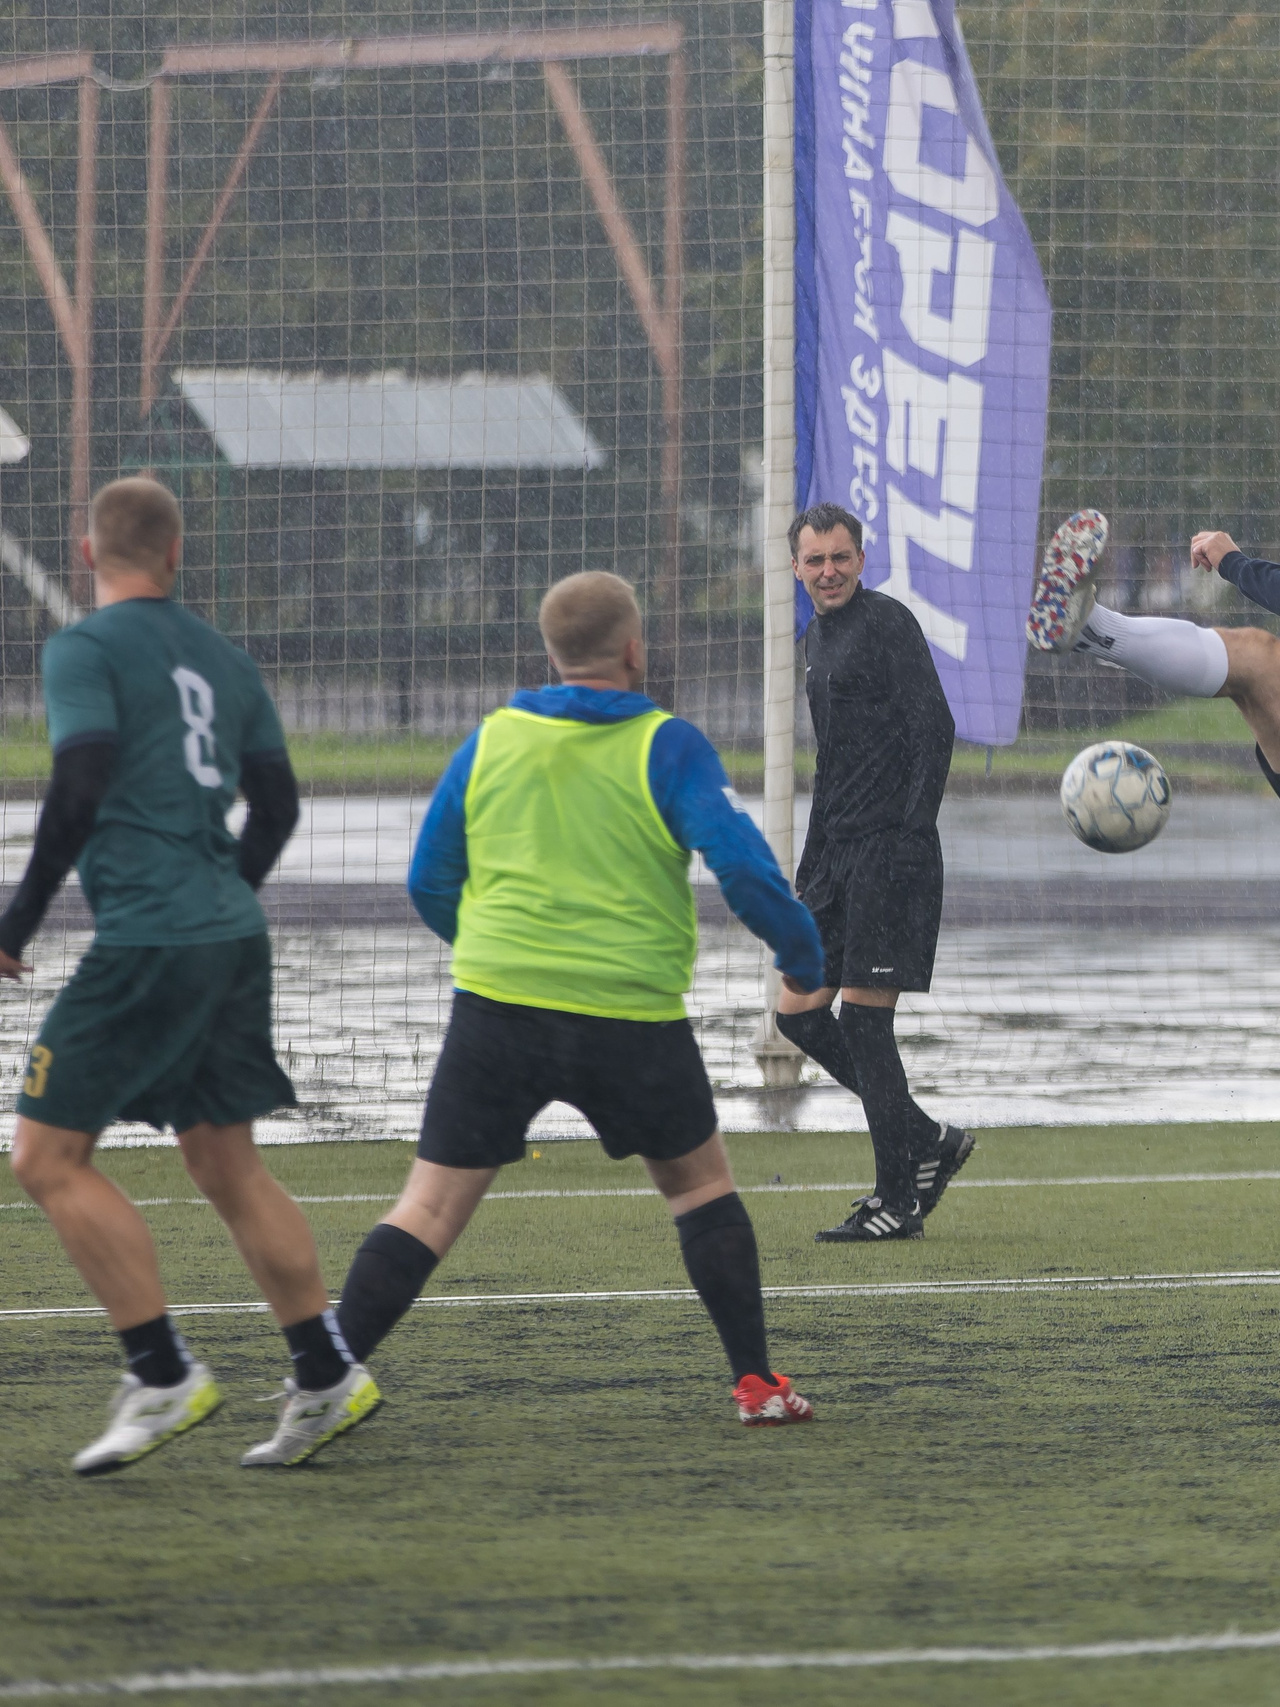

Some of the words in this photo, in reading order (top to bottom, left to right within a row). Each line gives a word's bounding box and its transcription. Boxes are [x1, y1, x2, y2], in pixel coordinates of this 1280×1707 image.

[839, 0, 879, 343] ЧИНАЕТСЯ
[876, 0, 999, 661] ОРЕЦ
[172, 666, 223, 787] 8
[24, 1045, 53, 1098] 3
